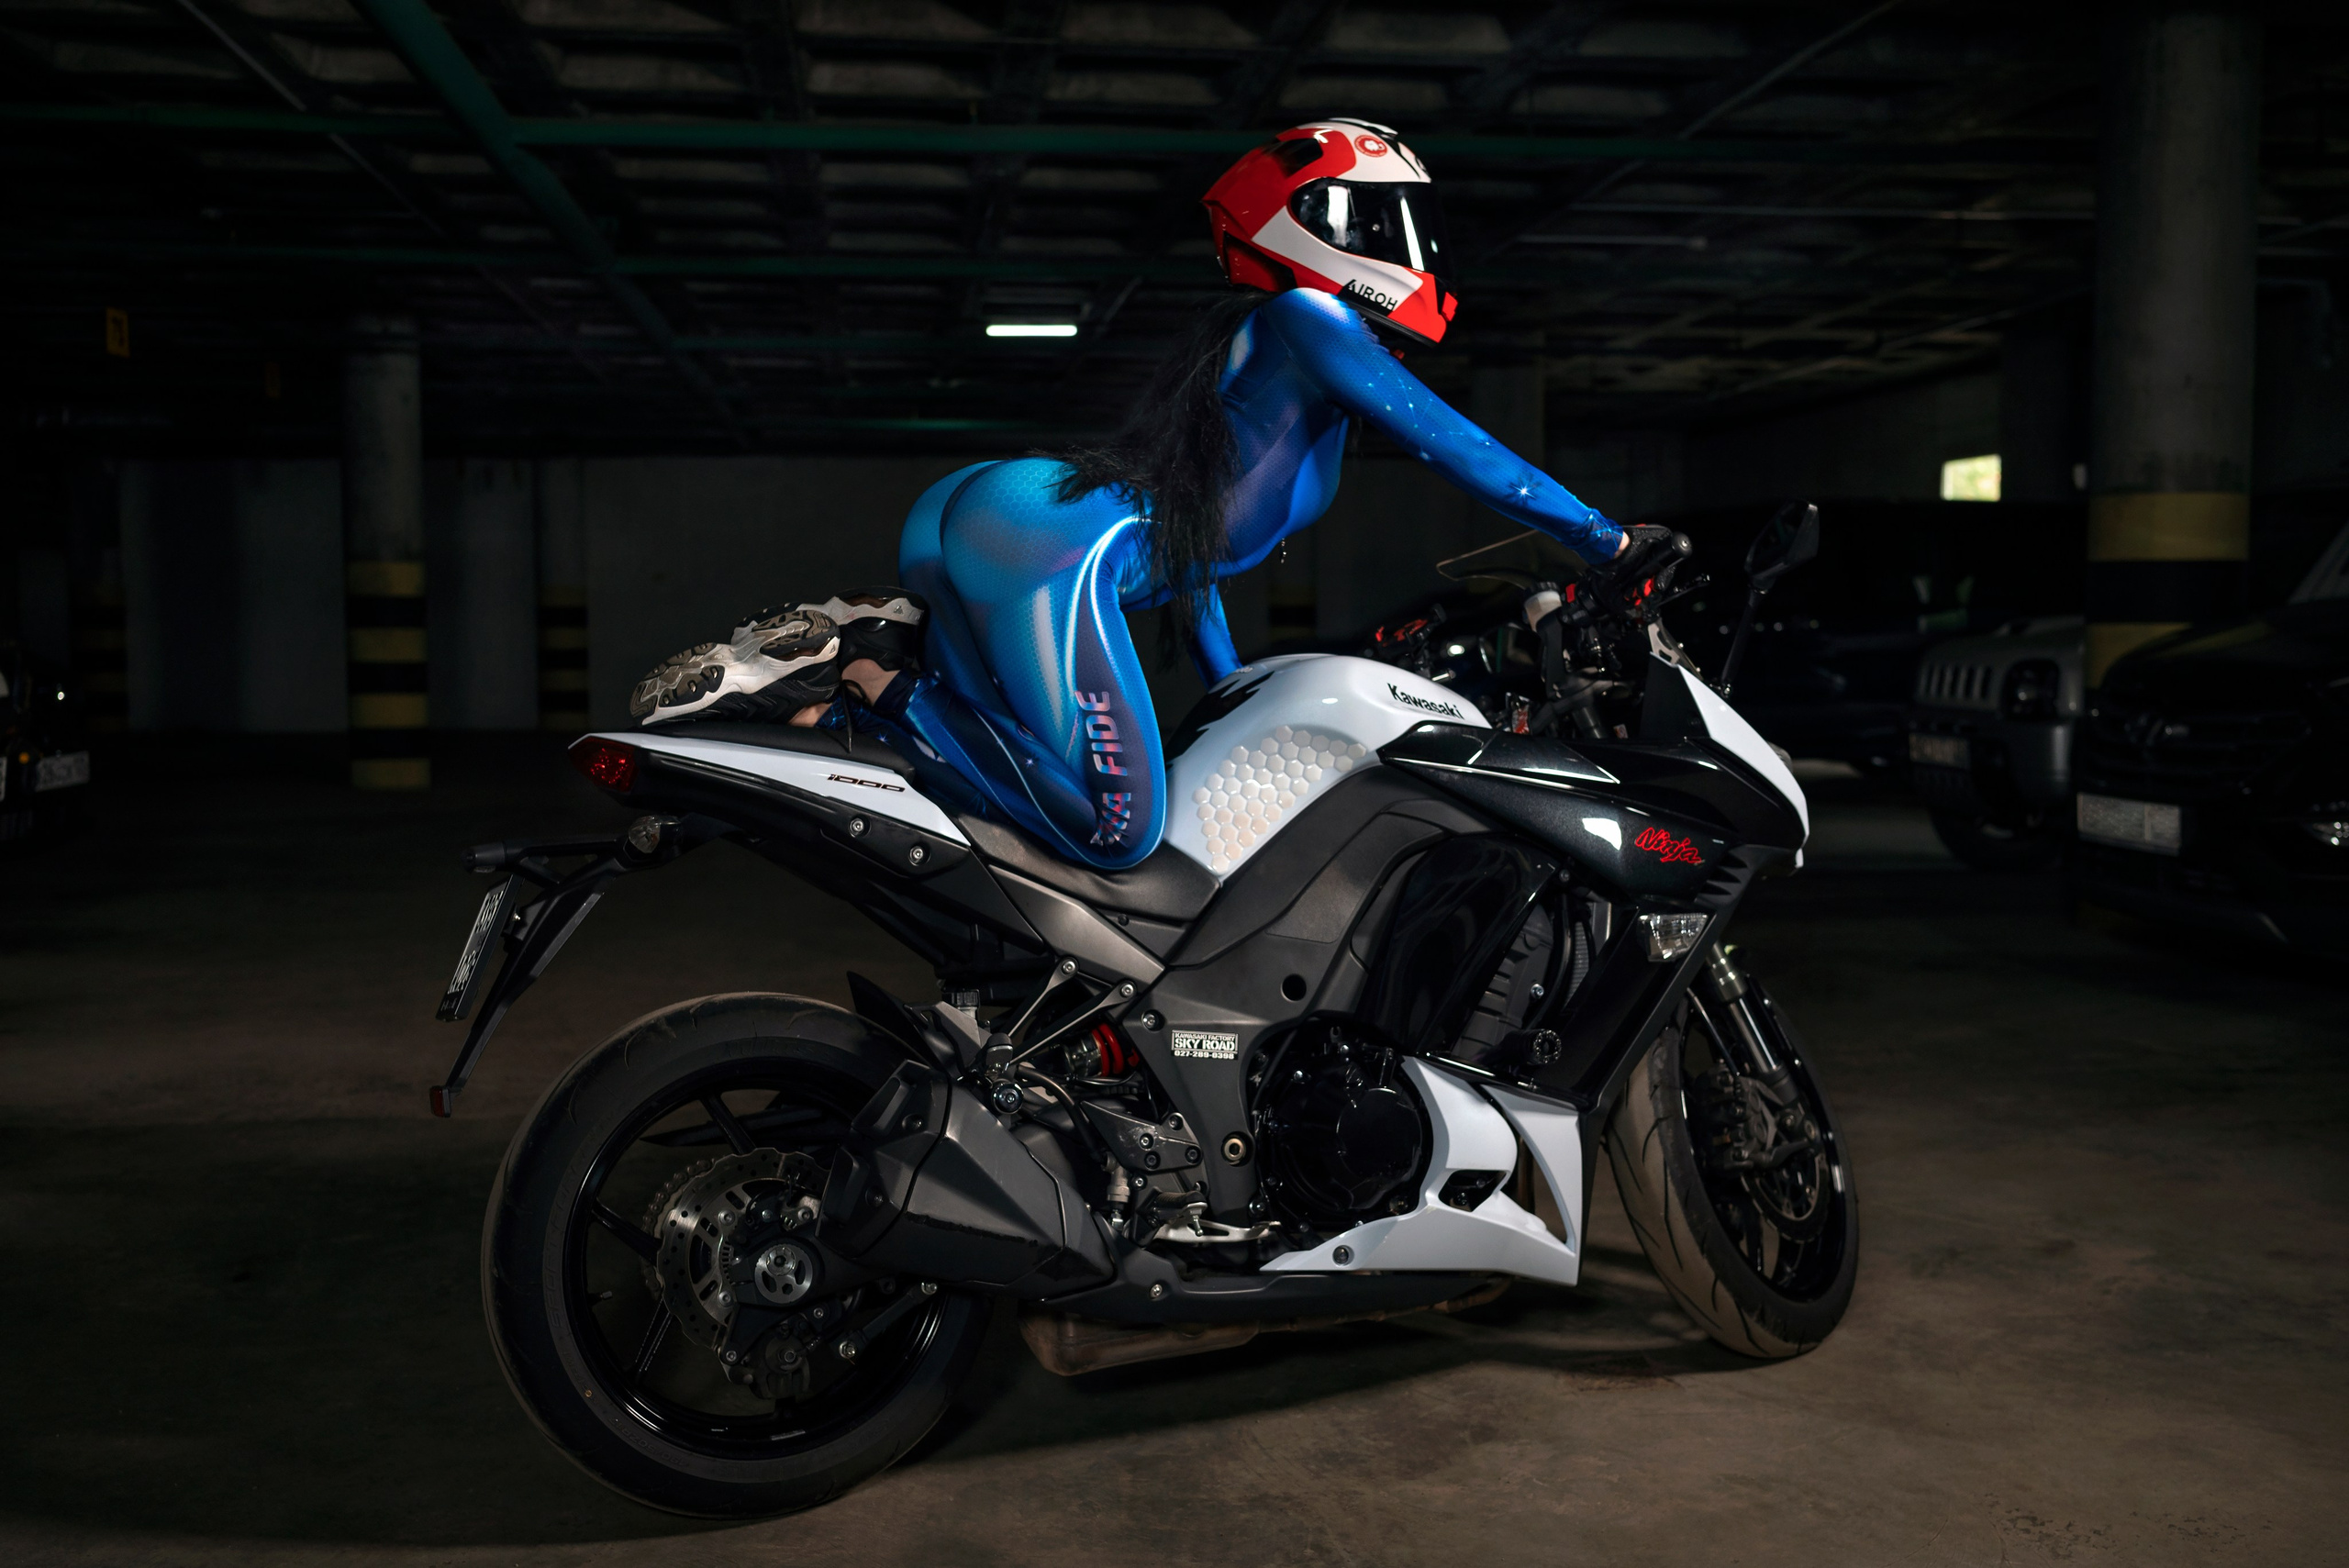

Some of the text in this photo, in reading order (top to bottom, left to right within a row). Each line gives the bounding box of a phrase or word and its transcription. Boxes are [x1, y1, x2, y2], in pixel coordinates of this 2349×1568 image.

[1345, 279, 1397, 311] AIROH
[1387, 683, 1464, 719] Kawasaki
[1074, 691, 1129, 775] FIDE
[828, 773, 906, 792] 1000
[1174, 1032, 1208, 1040] KAWASAKI
[1174, 1038, 1235, 1051] SKY ROAD
